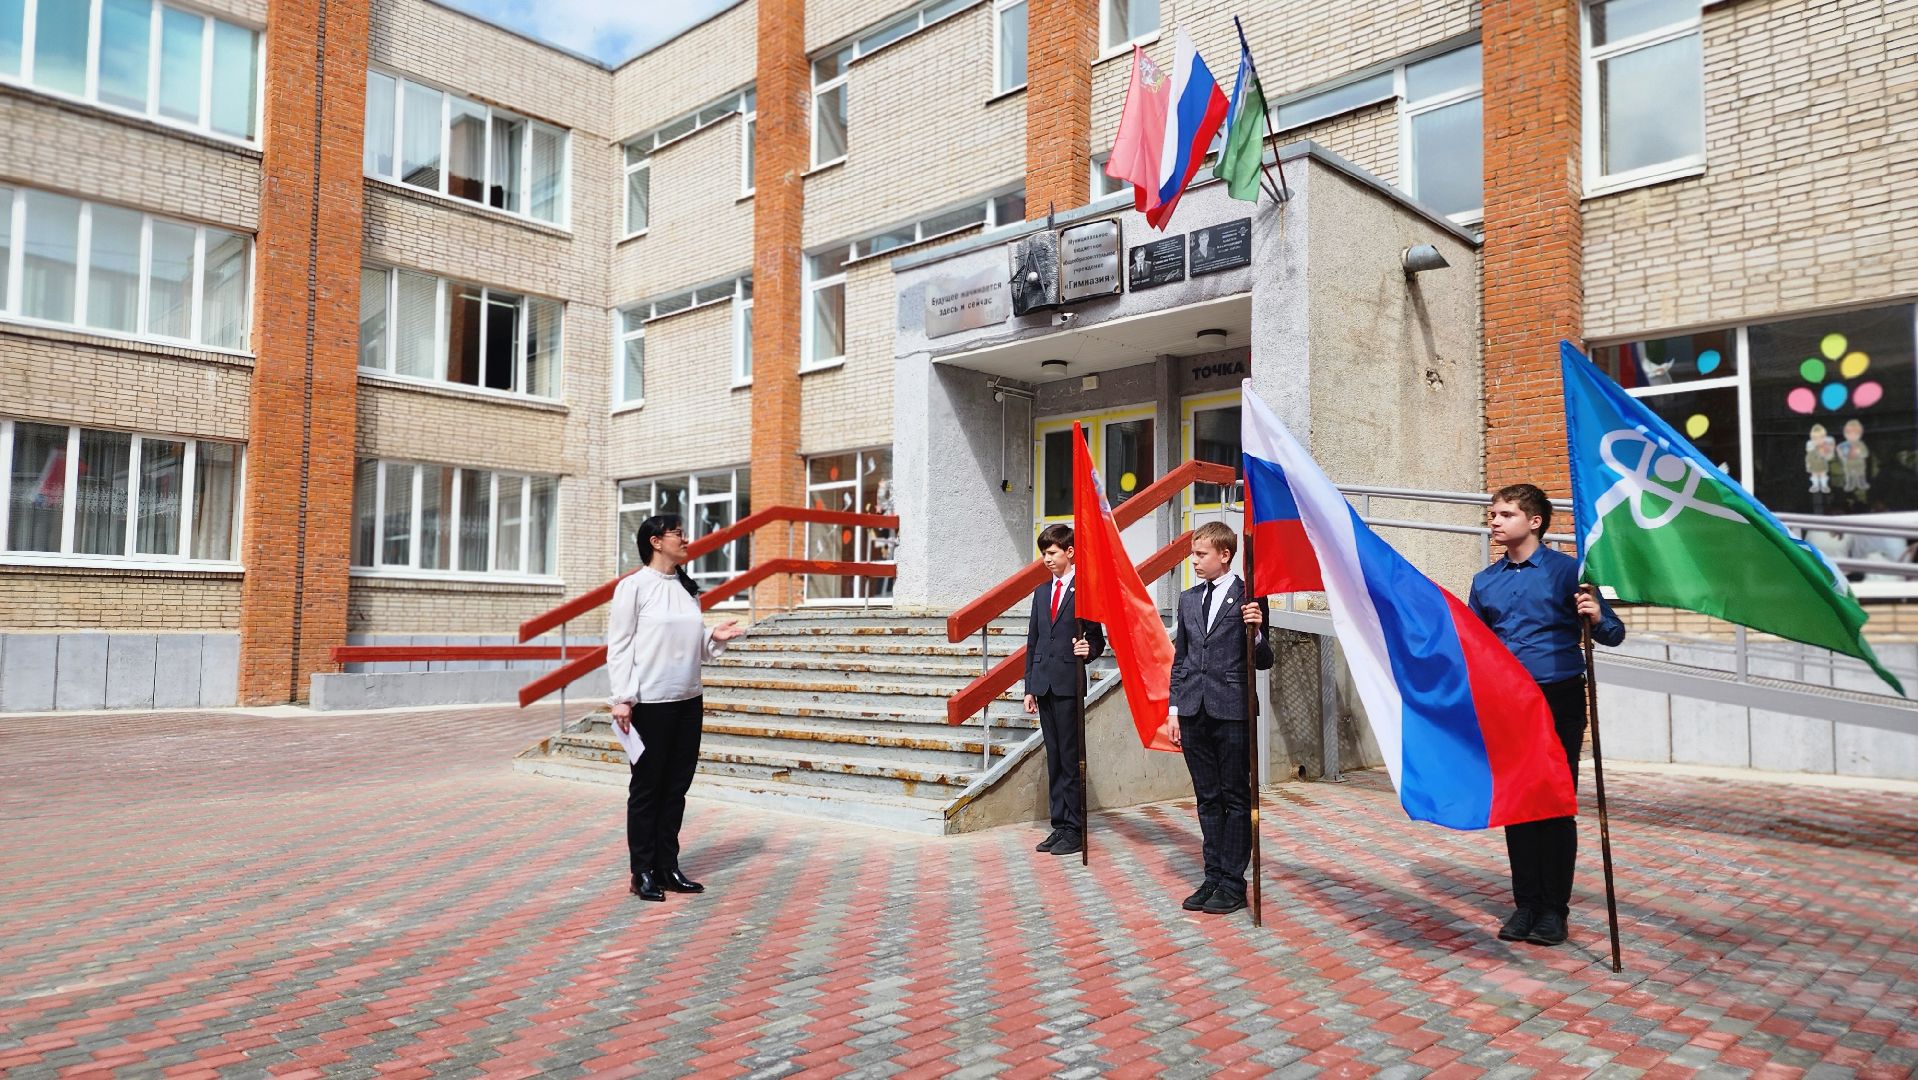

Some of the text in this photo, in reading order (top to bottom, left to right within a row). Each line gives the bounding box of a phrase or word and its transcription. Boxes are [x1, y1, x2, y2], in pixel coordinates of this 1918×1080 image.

[1065, 275, 1115, 290] «Гимназия»
[932, 282, 1002, 306] Будущее начинается
[940, 305, 958, 316] здесь
[968, 297, 993, 309] сейчас
[1192, 361, 1245, 381] ТОЧКА
